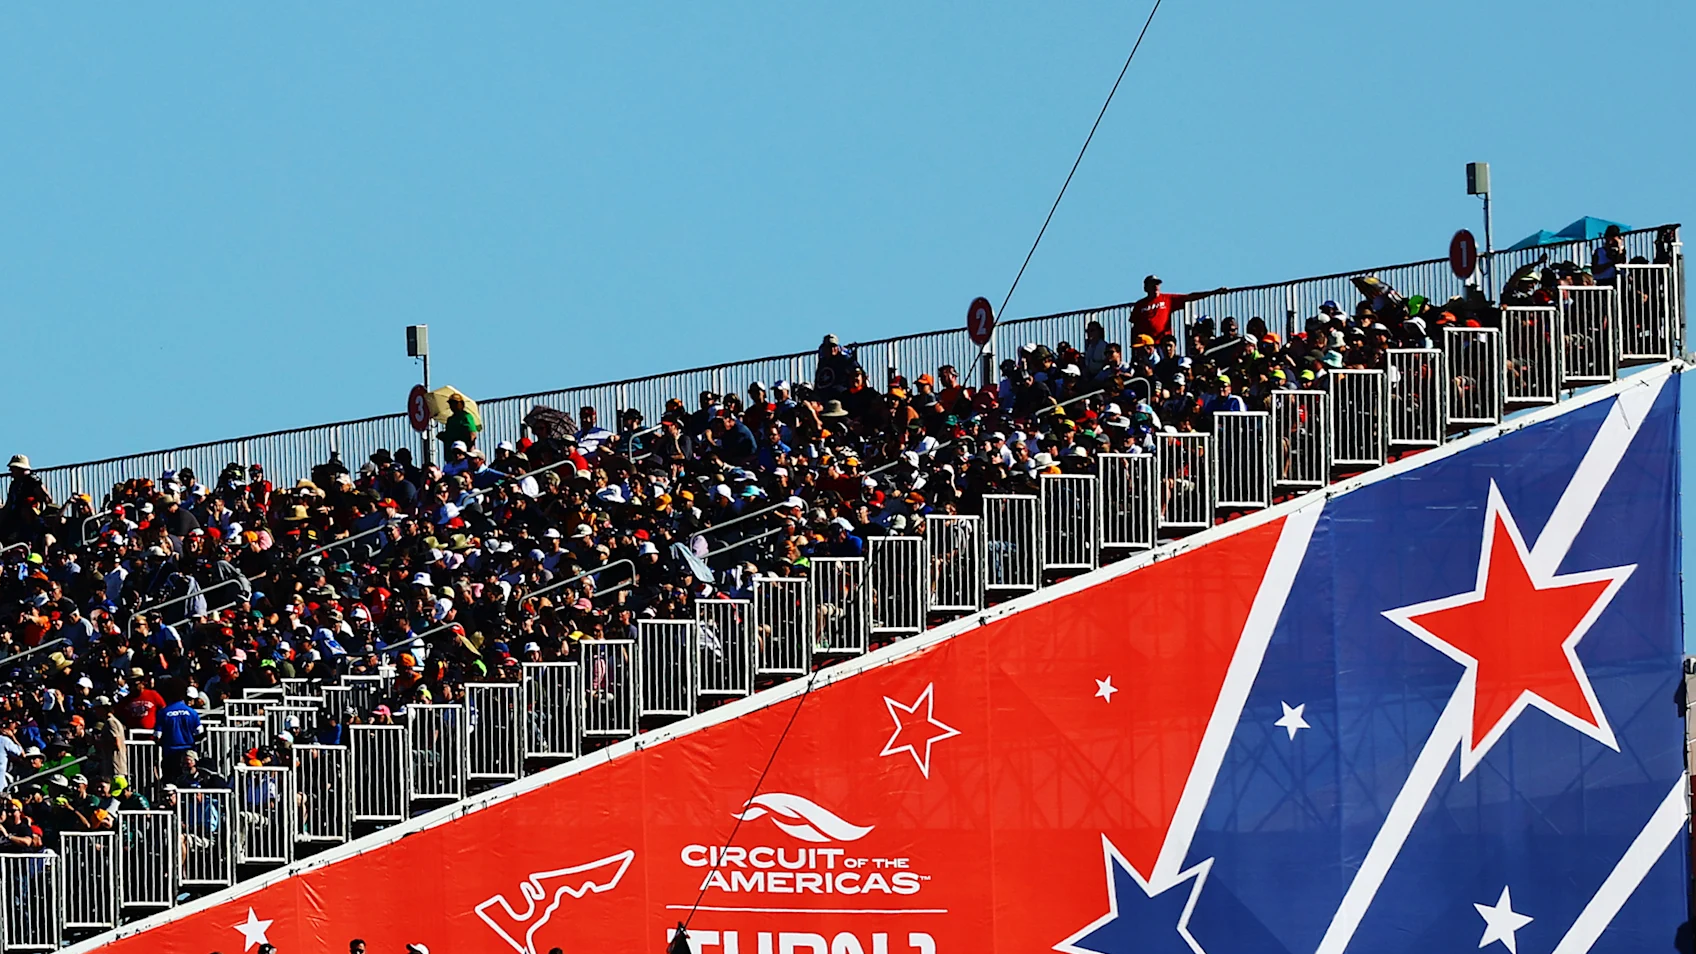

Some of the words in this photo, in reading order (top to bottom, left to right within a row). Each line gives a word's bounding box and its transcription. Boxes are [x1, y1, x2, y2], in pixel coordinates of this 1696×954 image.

[1460, 241, 1467, 268] 1
[975, 308, 987, 336] 2
[415, 395, 424, 422] 3
[166, 709, 190, 717] COTA
[680, 844, 844, 869] CIRCUIT
[844, 857, 869, 869] OF
[872, 857, 910, 869] THE
